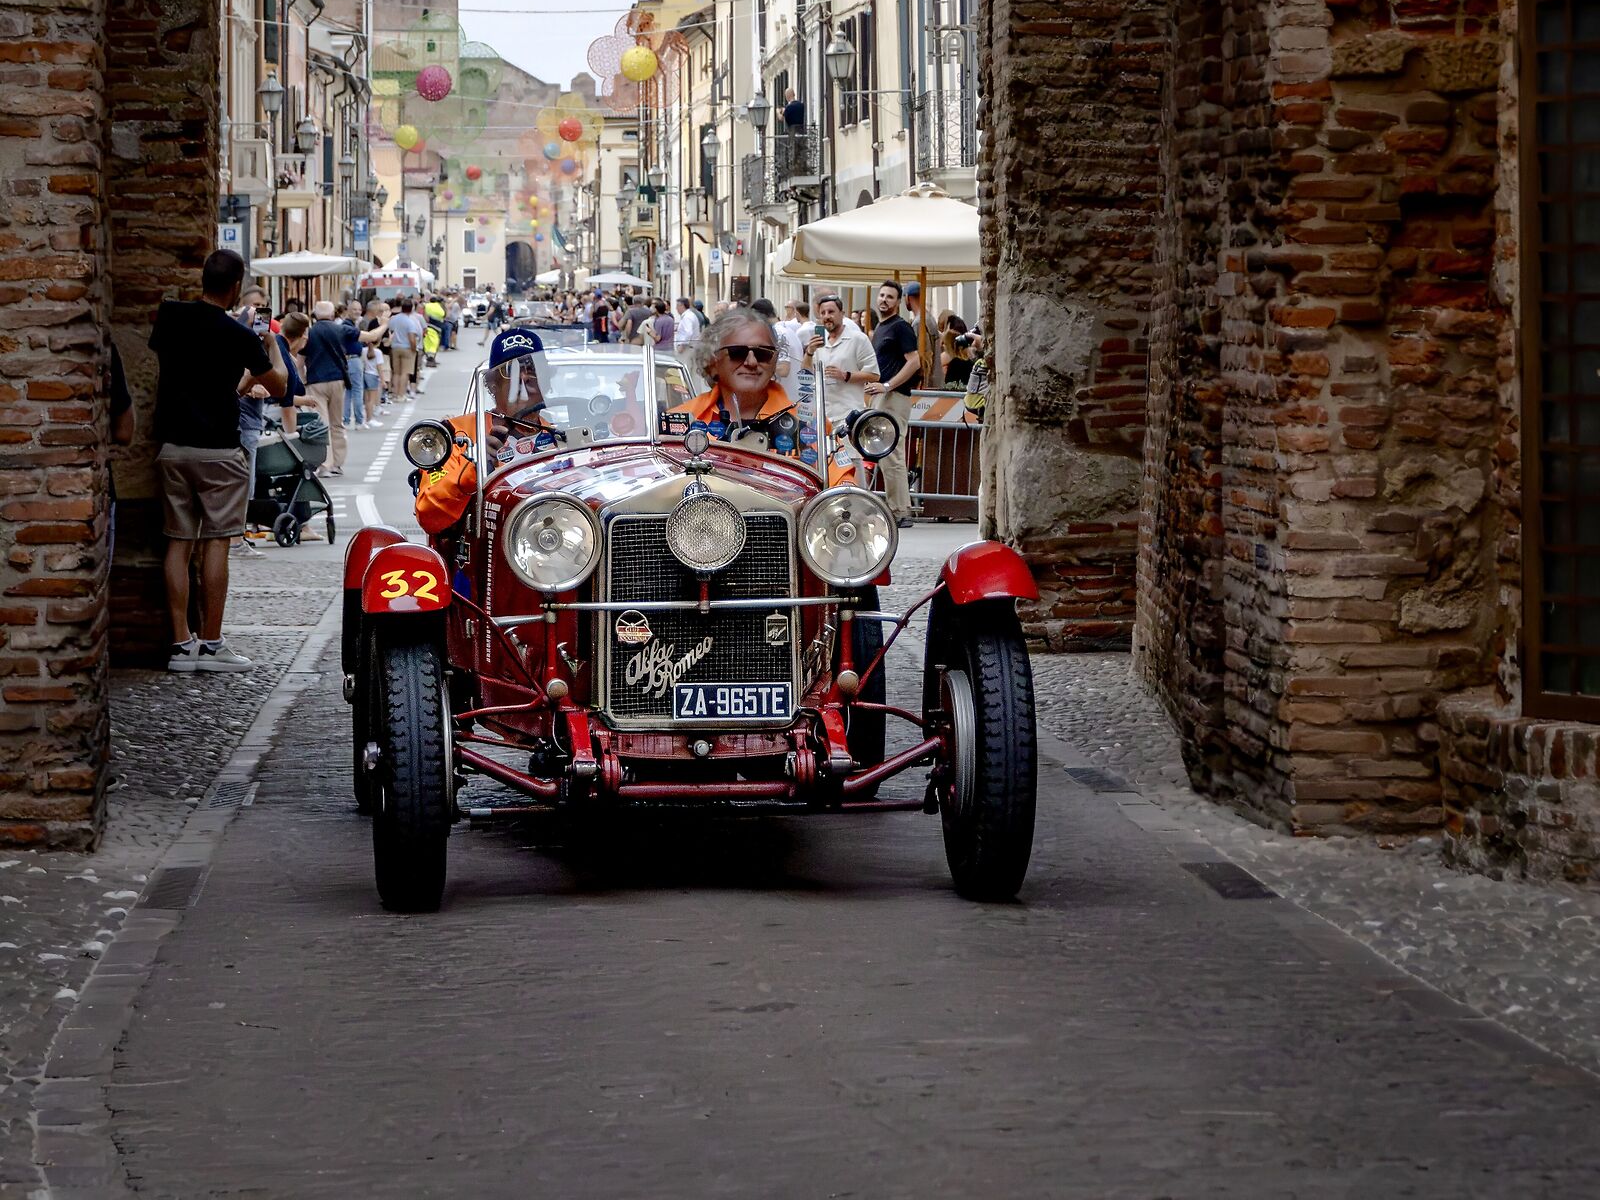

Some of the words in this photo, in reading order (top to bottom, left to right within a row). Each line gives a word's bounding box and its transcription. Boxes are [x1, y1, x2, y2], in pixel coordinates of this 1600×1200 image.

[380, 569, 440, 603] 32
[625, 638, 675, 695] Alfa
[653, 635, 714, 699] Romeo
[680, 687, 785, 716] ZA-965TE
